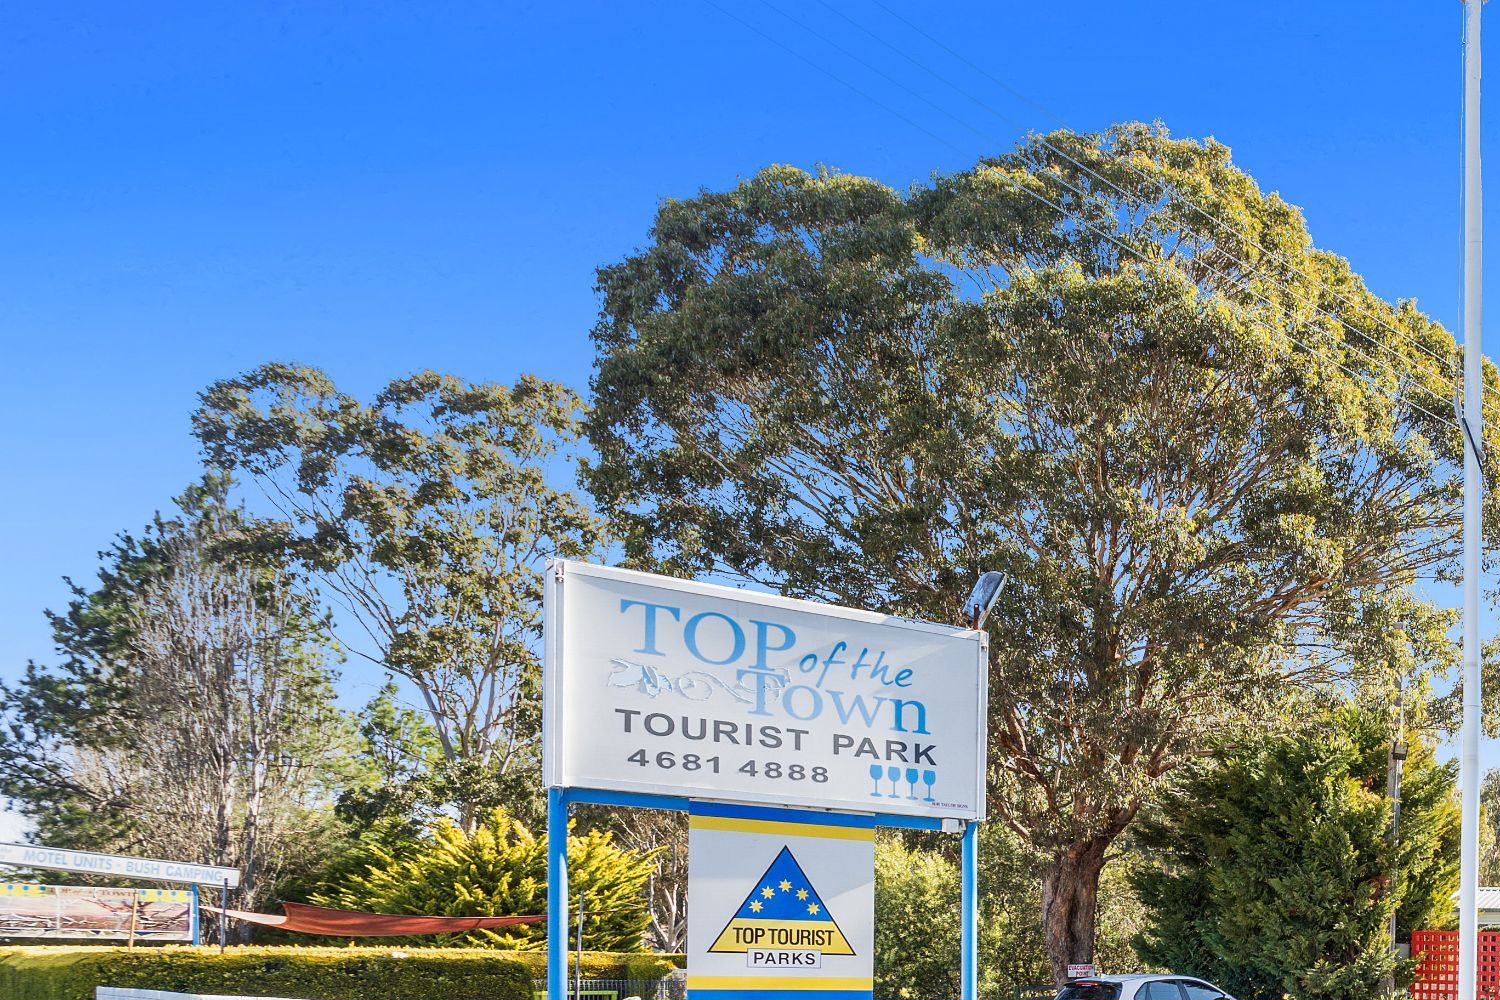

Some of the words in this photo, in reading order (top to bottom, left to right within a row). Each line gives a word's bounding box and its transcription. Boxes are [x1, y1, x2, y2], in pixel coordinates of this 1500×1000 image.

[620, 598, 797, 672] TOP
[799, 641, 847, 689] of
[850, 647, 913, 689] the
[614, 708, 810, 752] TOURIST
[833, 733, 938, 767] PARK
[626, 747, 721, 775] 4681
[738, 759, 830, 784] 4888
[23, 850, 68, 866] MOTEL
[73, 856, 112, 871] UNITS
[126, 860, 161, 875] BUSH
[166, 865, 223, 882] CAMPING
[733, 927, 765, 944] TOP
[768, 928, 835, 946] TOURIST
[753, 952, 816, 965] PARKS
